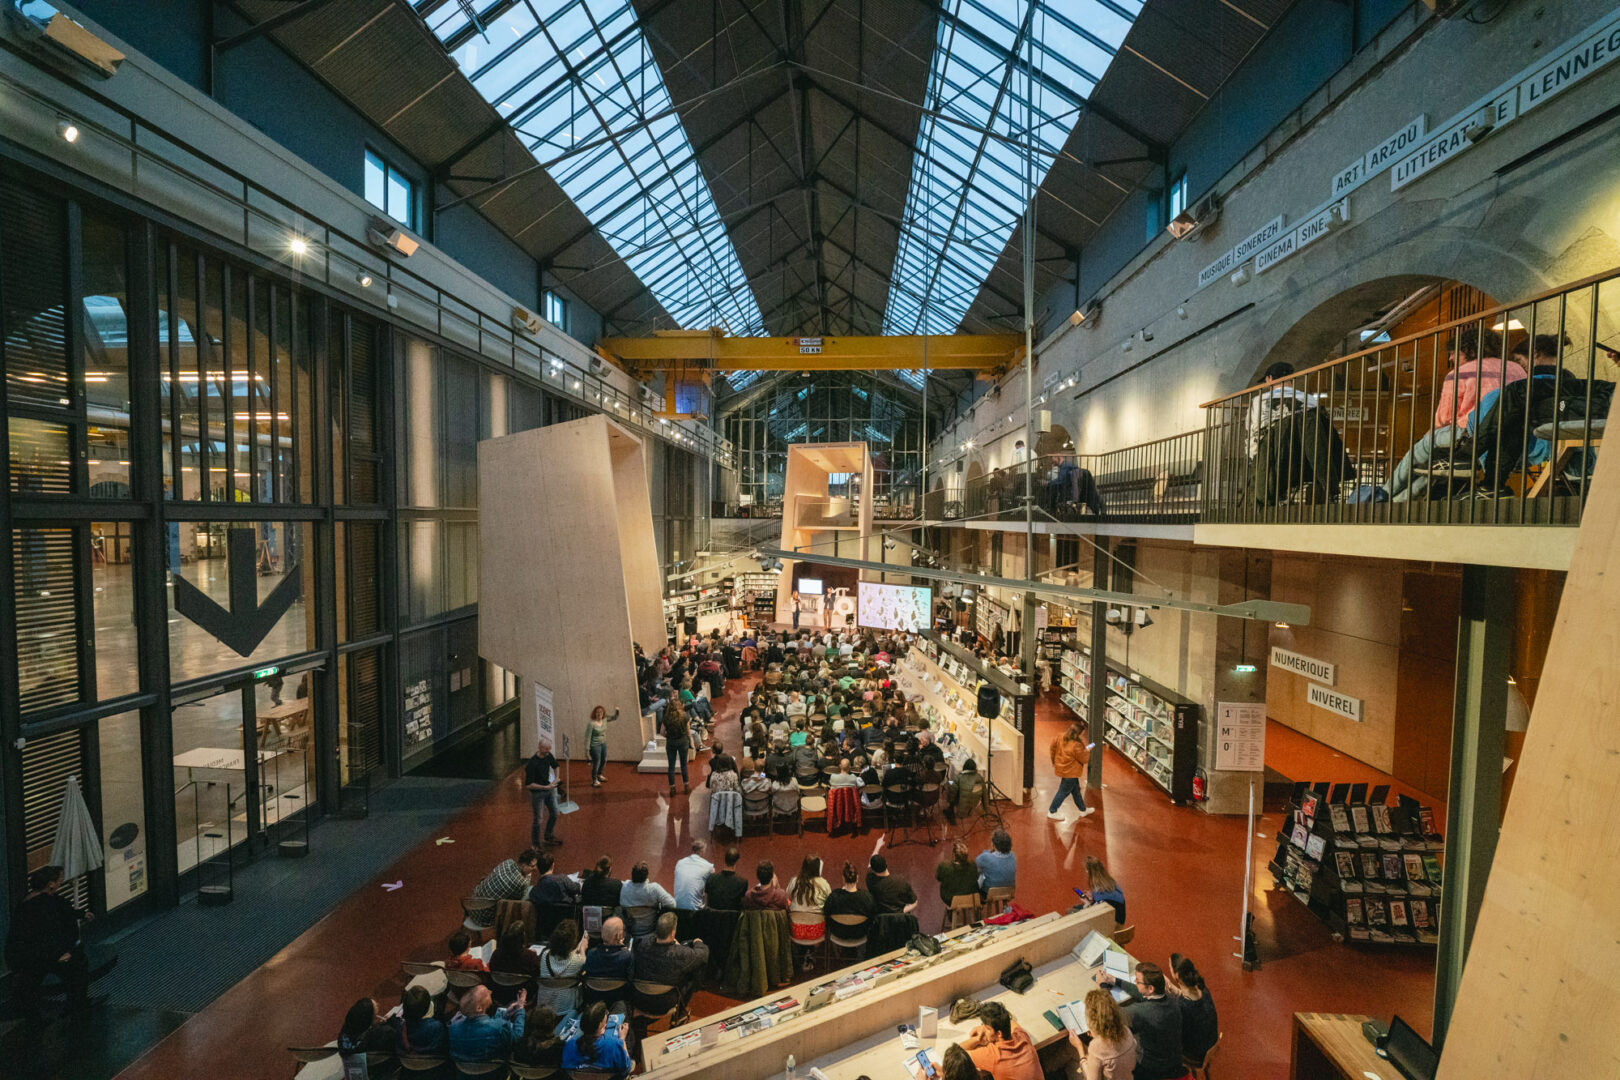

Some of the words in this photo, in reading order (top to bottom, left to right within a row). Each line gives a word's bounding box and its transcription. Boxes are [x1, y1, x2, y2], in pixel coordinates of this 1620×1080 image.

[1336, 165, 1360, 192] ART
[1200, 254, 1231, 283] MUSIQUE
[1236, 221, 1279, 259] SONEREZH
[1274, 651, 1330, 680] NUMÉRIQUE
[1311, 688, 1355, 716] NIVEREL
